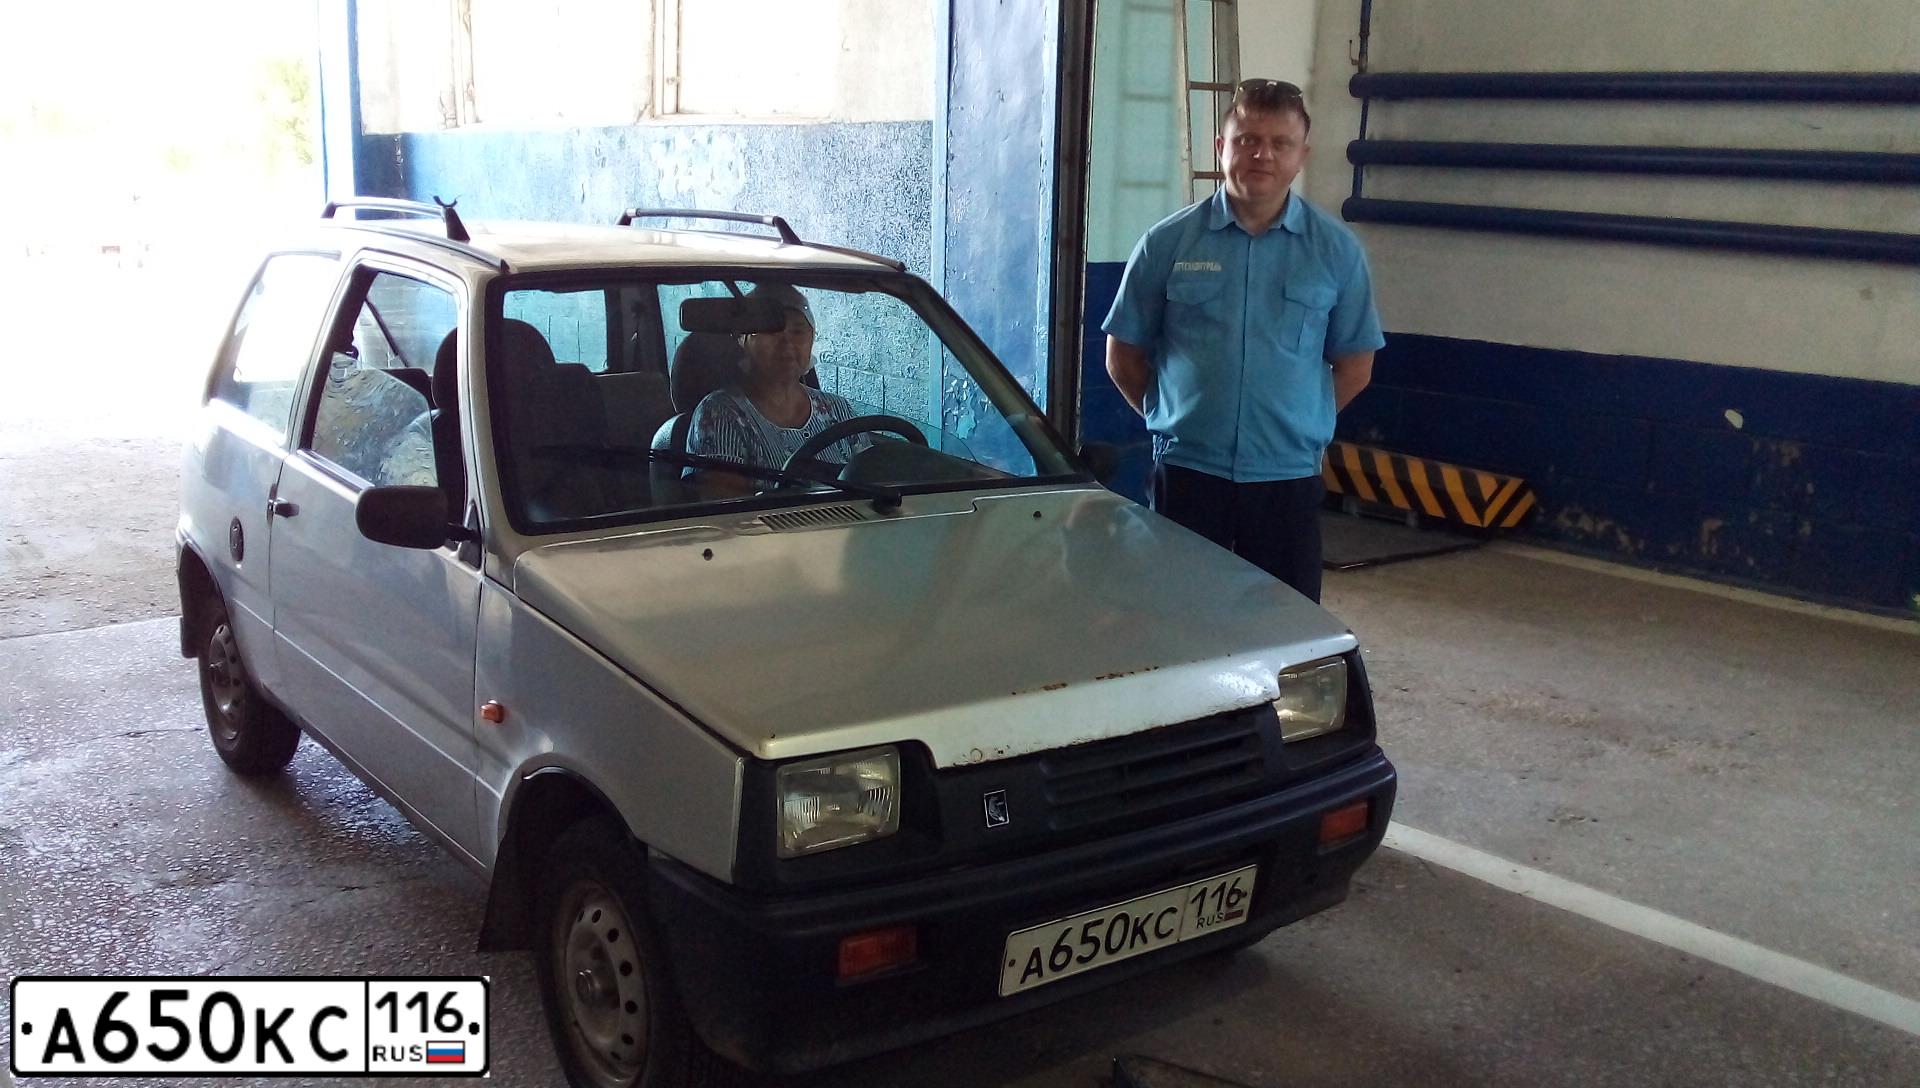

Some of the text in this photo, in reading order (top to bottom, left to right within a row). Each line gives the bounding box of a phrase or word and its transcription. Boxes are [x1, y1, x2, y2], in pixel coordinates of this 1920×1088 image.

[1020, 877, 1241, 984] А650КС 116
[1196, 912, 1224, 929] RUS
